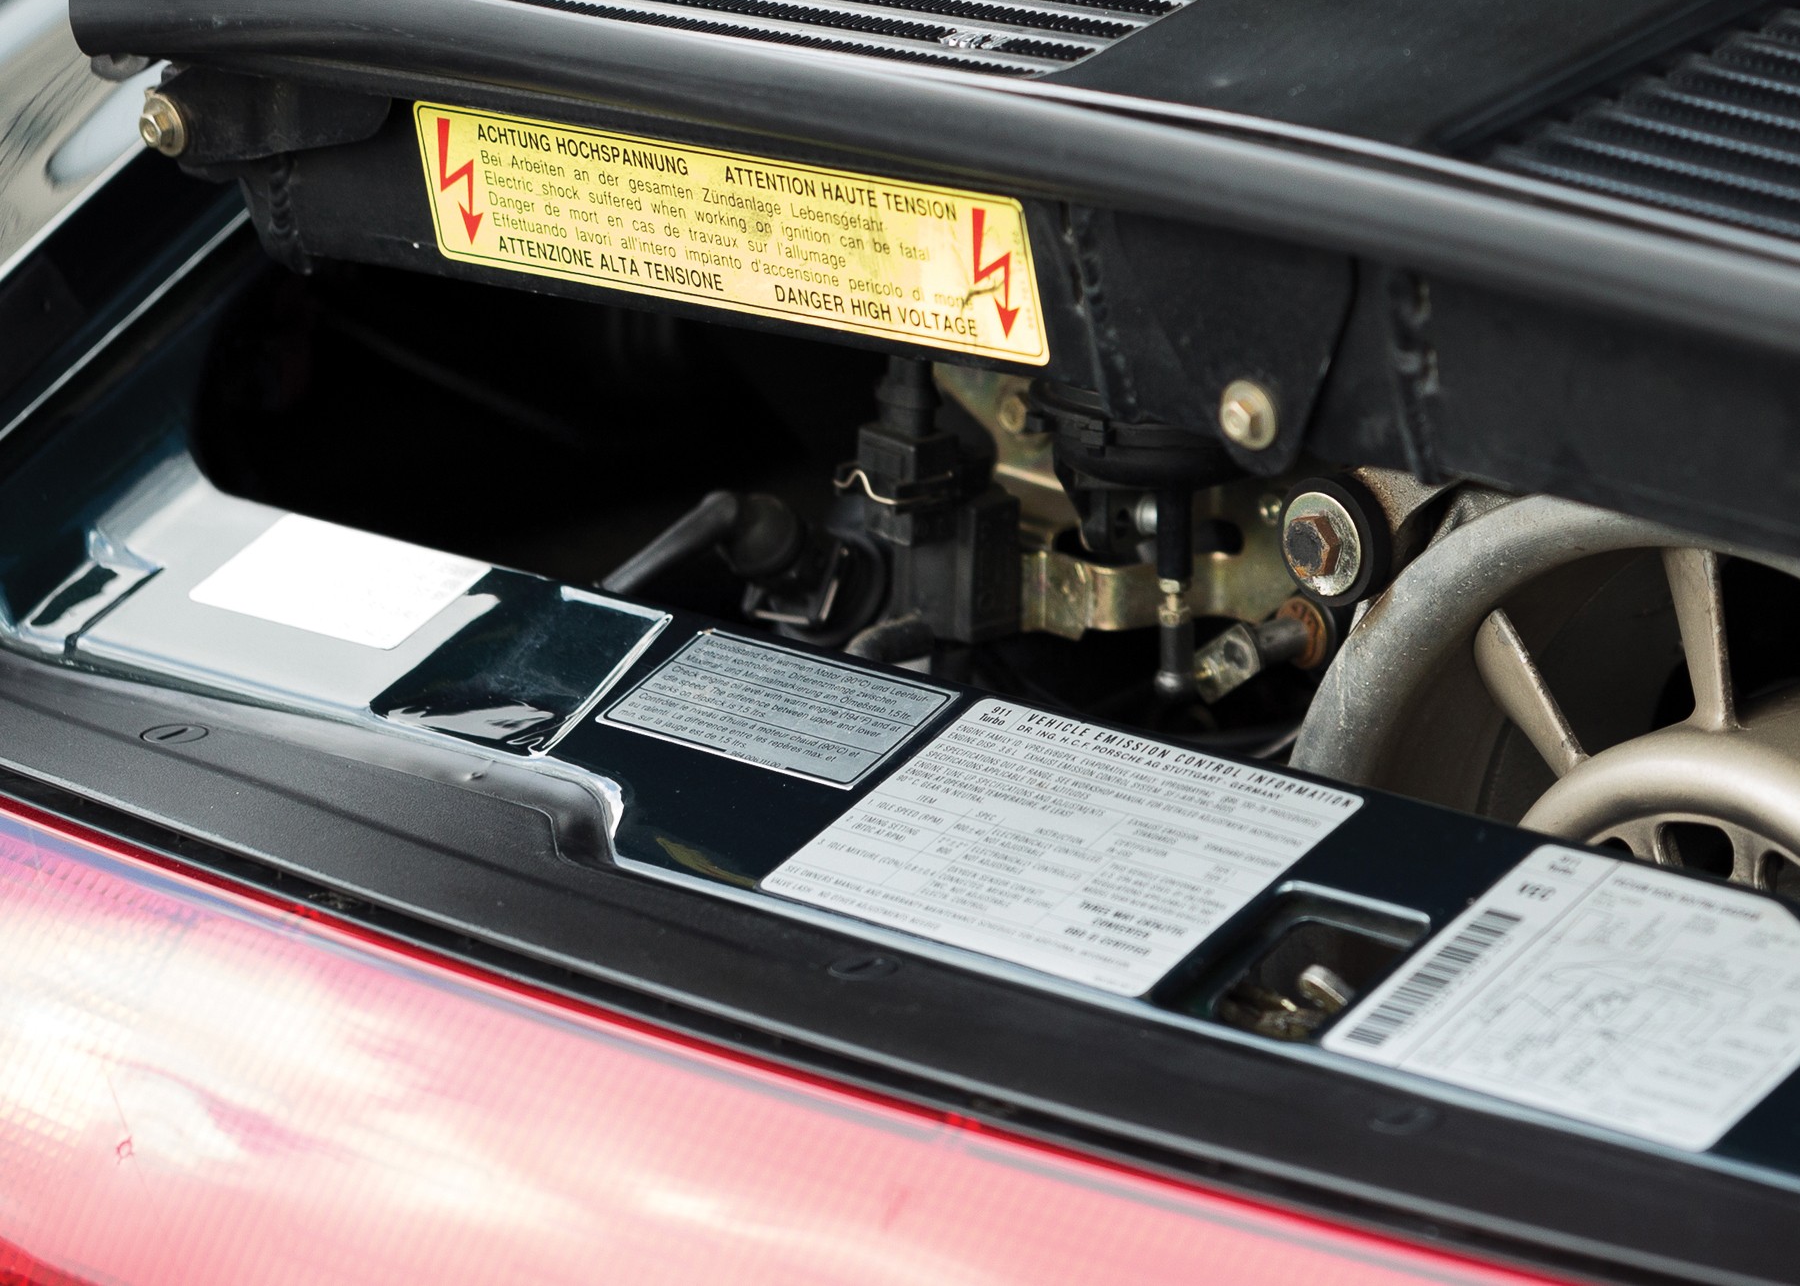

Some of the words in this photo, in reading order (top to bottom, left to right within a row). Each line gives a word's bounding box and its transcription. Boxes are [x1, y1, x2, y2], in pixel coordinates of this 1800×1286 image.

[477, 123, 552, 152] ACHTUNG
[555, 136, 688, 176] HOCHSPANNUNG
[725, 165, 816, 198] ATTENTION
[820, 181, 878, 209] HAUTE
[882, 192, 957, 221] TENSION
[480, 149, 502, 167] Bei
[511, 154, 565, 177] Arbeiten
[573, 168, 590, 182] an
[598, 170, 619, 186] der
[628, 178, 693, 200] gesamten
[701, 187, 781, 218] Zündanlage
[790, 202, 883, 233] Lebensgefahr
[484, 169, 533, 193] Electric
[541, 181, 580, 200] shock
[588, 190, 642, 211] suffered
[650, 200, 686, 219] when
[694, 210, 747, 234] working
[755, 220, 772, 234] on
[780, 221, 831, 244] ignition
[839, 235, 864, 250] can
[871, 237, 890, 255] be
[899, 242, 929, 260] fatal
[488, 190, 535, 215] Danger
[544, 201, 560, 217] de
[569, 208, 599, 224] mort
[607, 215, 623, 228] en
[631, 219, 655, 234] cas
[663, 222, 680, 239] de
[688, 227, 738, 248] travaux
[747, 239, 768, 253] sur
[776, 241, 846, 270] l'allumage
[492, 211, 567, 239] Effettuando
[575, 226, 612, 246] lavori
[620, 235, 676, 258] all'intero
[684, 249, 742, 270] impianto
[750, 258, 839, 287] d'accensione
[848, 278, 903, 298] pericolo
[499, 235, 594, 268] ATTENZIONE
[600, 253, 640, 277] ALTA
[643, 260, 724, 292] TENSIONE
[774, 284, 845, 313] DANGER
[850, 298, 892, 322] HIGH
[897, 306, 978, 338] VOLTAGE
[651, 682, 679, 693] marks
[723, 666, 744, 675] und
[741, 670, 823, 698] Minimalmarkierung
[822, 693, 838, 701] am
[760, 653, 777, 662] bei
[776, 658, 814, 672] warmem
[813, 668, 841, 679] Motor
[840, 675, 872, 689] (90°C)
[870, 684, 891, 692] und
[787, 671, 856, 695] Differenzmenge
[855, 691, 897, 706] zwischen
[671, 665, 699, 678] Check
[699, 674, 730, 686] engine
[741, 685, 765, 695] level
[763, 692, 783, 701] with
[783, 697, 808, 708] warm
[808, 704, 839, 716] engine
[871, 721, 891, 729] and
[710, 686, 726, 696] The
[726, 692, 771, 708] difference
[770, 703, 809, 718] between
[809, 715, 837, 726] upper
[836, 722, 857, 731] and
[854, 726, 881, 737] lower
[978, 712, 1005, 726] Turbo
[991, 706, 1012, 717] 911
[660, 721, 688, 732] jauge
[688, 728, 704, 736] est
[703, 732, 717, 740] de
[689, 707, 719, 719] niveau
[756, 726, 790, 738] moteur
[789, 735, 820, 747] chaud
[817, 742, 849, 755] (90°C)
[728, 729, 753, 739] entre
[753, 734, 768, 743] les
[802, 749, 823, 759] max.
[955, 724, 986, 737] ENGINE
[984, 731, 1011, 744] FAMILY
[925, 750, 984, 770] SPECIFICATIONS
[981, 765, 1026, 782] APPLICABLE
[1025, 777, 1038, 785] TO
[1035, 780, 1050, 789] ALL
[1050, 784, 1091, 800] ALTITUDES
[942, 745, 1001, 765] SPECIFICATIONS
[999, 760, 1017, 770] OUT
[1015, 764, 1027, 772] OF
[947, 731, 977, 744] ENGINE
[1023, 752, 1059, 766] EXHAUST
[1056, 761, 1094, 777] EMISSION
[1095, 772, 1130, 787] CONTROL
[1016, 724, 1033, 733] DR.
[1035, 729, 1056, 740] ING.
[1091, 744, 1142, 763] PORSCHE
[1143, 760, 1161, 768] AG
[1161, 764, 1221, 783] STUTTGART
[1229, 783, 1280, 799] GERMANY
[1027, 713, 1090, 737] VEHICLE
[1093, 731, 1171, 758] EMISSION
[1174, 753, 1241, 777] CONTROL
[1247, 772, 1351, 807] INFORMATION
[876, 801, 895, 811] IDLE
[893, 805, 920, 817] SPEED
[905, 767, 935, 780] ENGINE
[943, 778, 985, 793] OPERATING
[1049, 807, 1074, 816] LEAST
[913, 760, 944, 773] ENGINE
[942, 767, 977, 781] TUNE-UP
[975, 777, 1035, 798] SPECIFICATIONS
[1033, 793, 1051, 802] AND
[1050, 798, 1104, 816] ADJUSTMENTS
[916, 795, 937, 804] ITEM
[920, 781, 942, 790] GEAR
